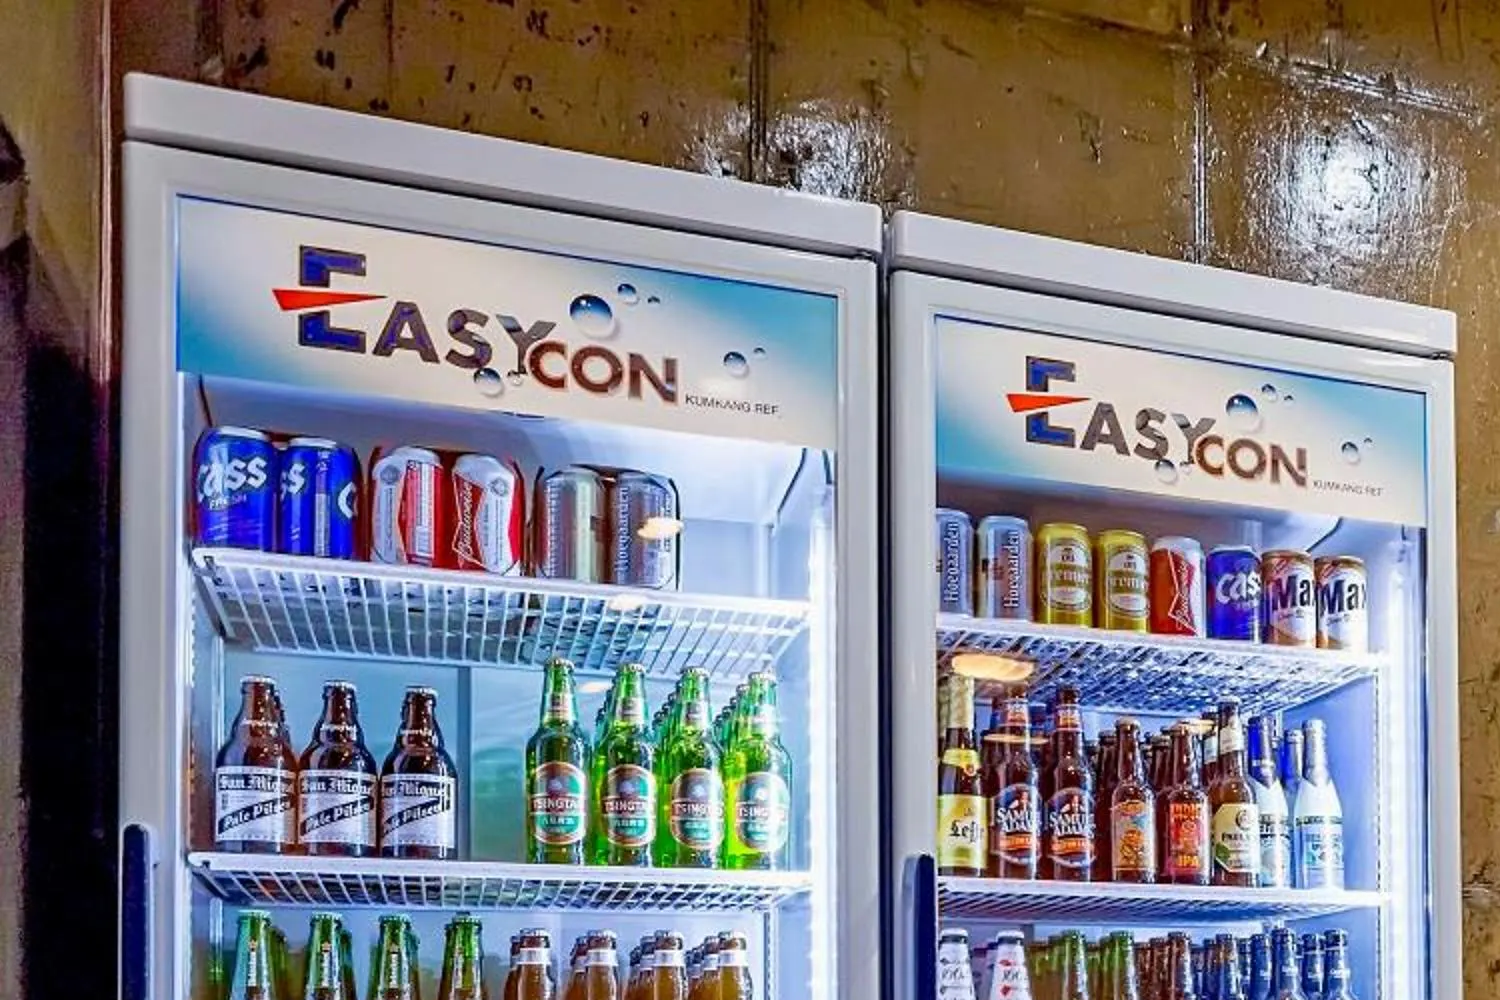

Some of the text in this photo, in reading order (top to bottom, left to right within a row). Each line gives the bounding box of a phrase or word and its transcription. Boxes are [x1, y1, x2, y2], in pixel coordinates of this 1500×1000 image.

[272, 245, 679, 406] EASYCON
[685, 393, 751, 413] KUMKANG
[1006, 355, 1308, 487] EASYCON
[1215, 569, 1262, 605] cas
[1271, 575, 1316, 612] Ma
